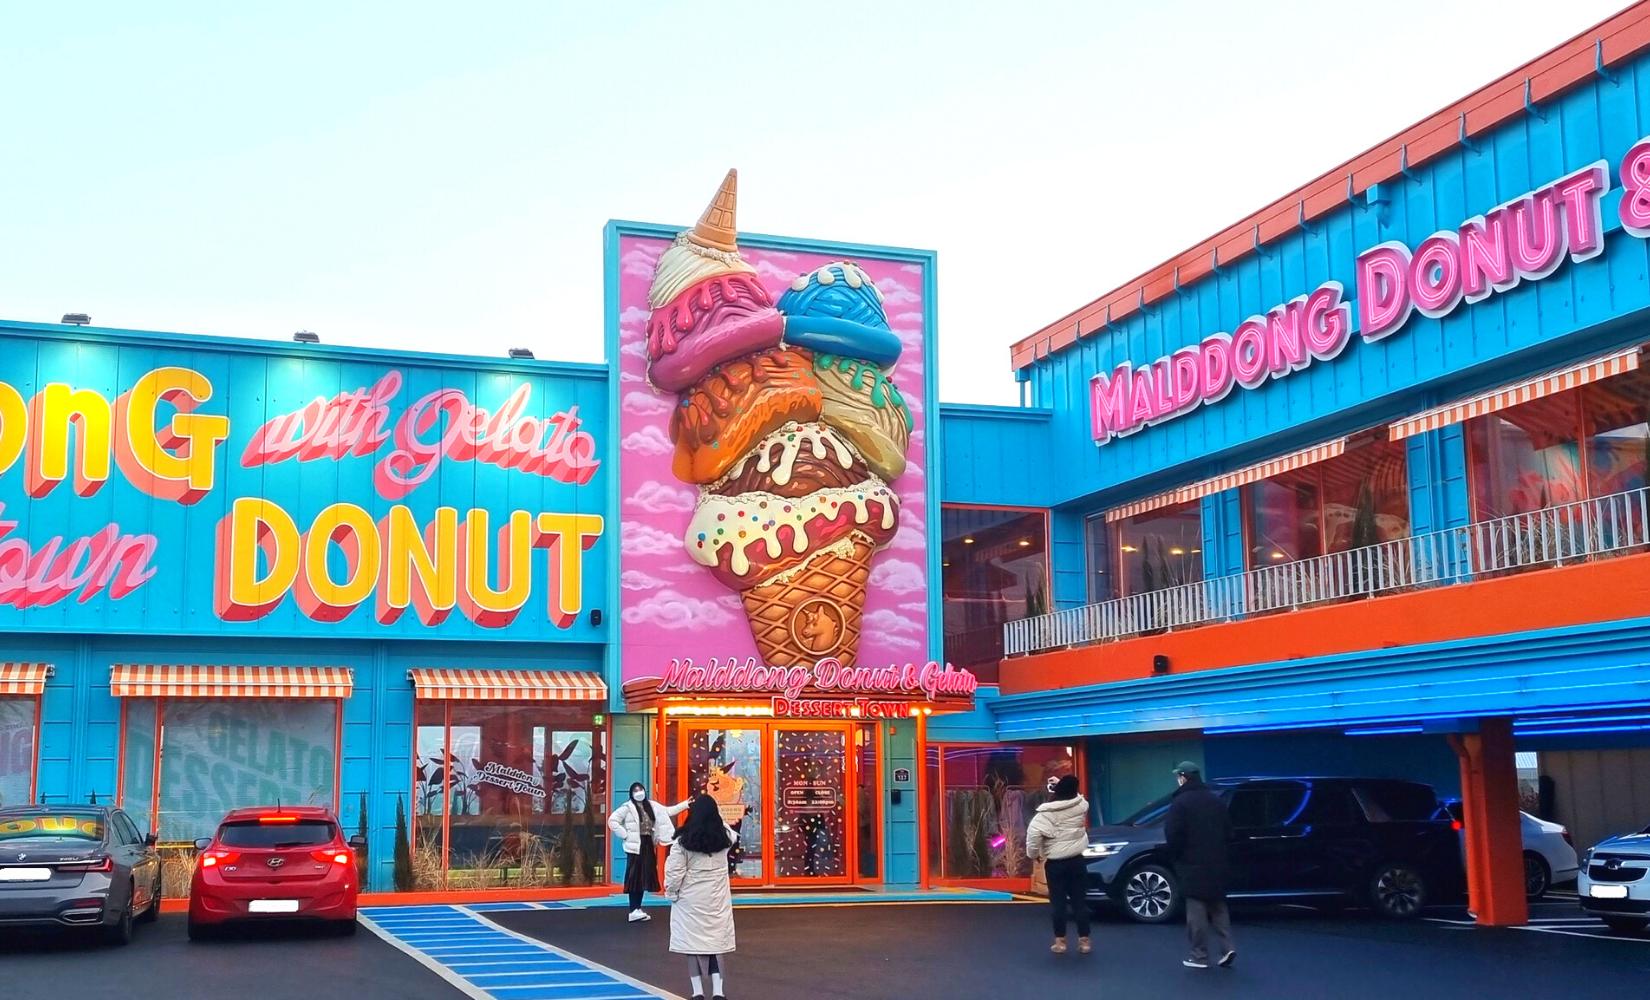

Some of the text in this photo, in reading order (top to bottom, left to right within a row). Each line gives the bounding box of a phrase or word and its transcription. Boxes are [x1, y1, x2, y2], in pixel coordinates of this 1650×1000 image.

[1090, 282, 1352, 447] MALDDONG
[1357, 159, 1610, 343] DONUT
[240, 370, 403, 468] with
[213, 497, 604, 630] DONUT
[657, 657, 812, 699] Malddong
[814, 657, 900, 692] Donut
[901, 663, 920, 690] &
[772, 696, 910, 718] DESSERT TOWN
[208, 711, 332, 795] GELATO
